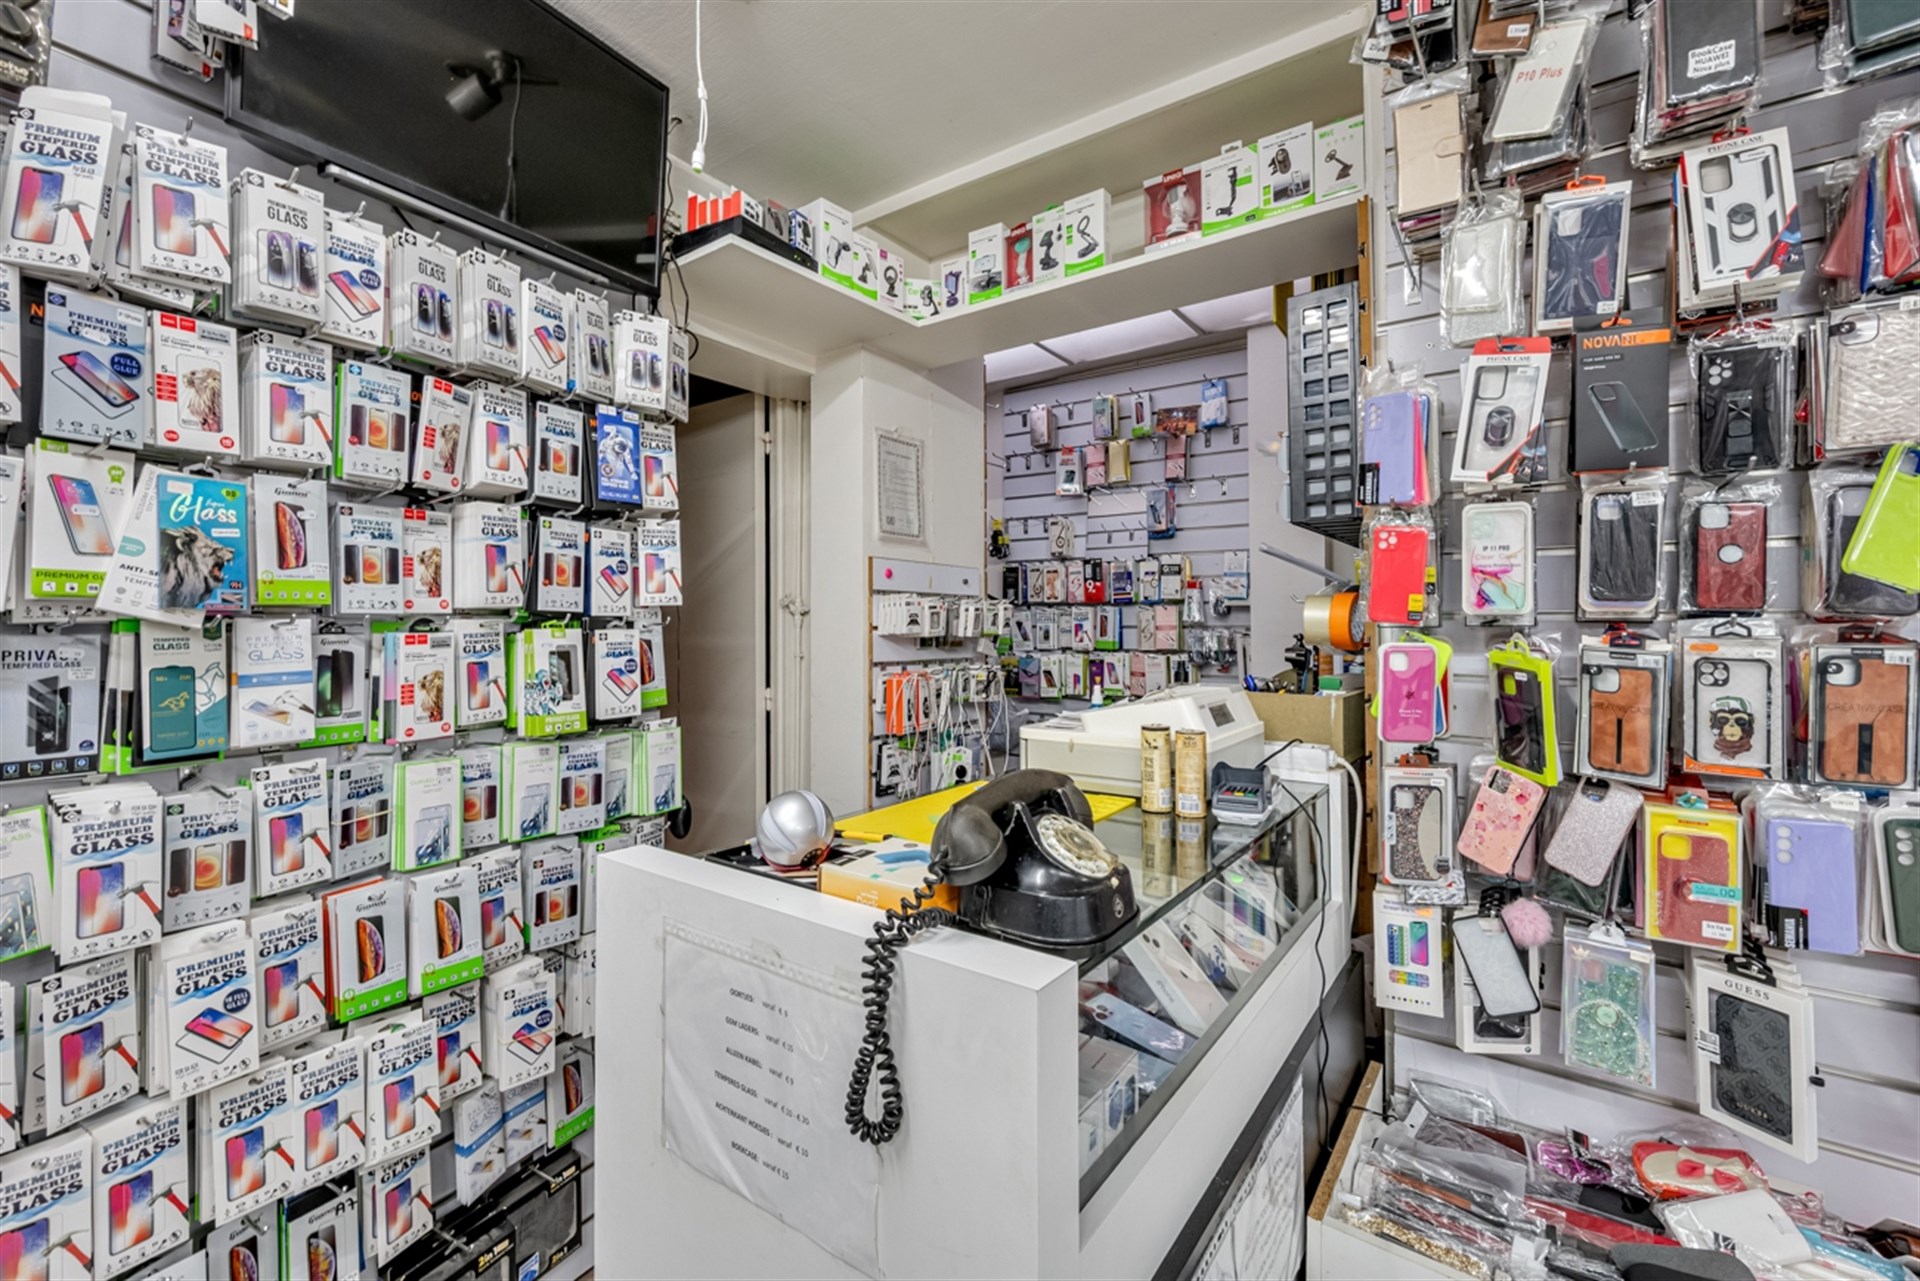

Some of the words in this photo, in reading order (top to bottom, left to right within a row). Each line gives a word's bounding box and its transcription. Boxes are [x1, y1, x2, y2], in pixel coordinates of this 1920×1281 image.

[1690, 43, 1733, 59] BookCase
[1694, 52, 1730, 65] HUAWEI
[1516, 70, 1536, 83] P10
[1539, 67, 1564, 78] Plus
[1693, 62, 1712, 74] Nova
[1714, 60, 1731, 71] plus
[24, 121, 100, 144] PREMIUM
[25, 133, 98, 152] TEMPERED
[1707, 140, 1738, 152] PHONE
[1740, 135, 1763, 145] CASE
[20, 140, 98, 165] GLASS
[146, 142, 219, 169] PREMIUM
[149, 152, 218, 176] TEMPERED
[146, 161, 221, 188] GLASS
[267, 206, 308, 229] GLASS
[330, 234, 375, 252] PREMIUM
[330, 242, 375, 260] TEMPERED
[328, 247, 375, 267] GLASS
[418, 262, 446, 284] GLASS
[487, 278, 511, 298] GLASS
[68, 310, 128, 332] PREMIUM
[534, 305, 563, 323] GLASS
[587, 315, 604, 330] GLASS
[70, 320, 126, 338] TEMPERED
[632, 333, 658, 346] GLASS
[1583, 334, 1636, 349] NOVANI
[114, 356, 139, 368] FULL
[265, 346, 326, 363] PREMIUM
[267, 354, 325, 371] TEMPERED
[113, 363, 139, 377] GLUE
[265, 361, 326, 381] GLASS
[359, 377, 401, 392] PRIVACY
[483, 392, 523, 406] PREMIUM
[484, 399, 522, 412] TEMPERED
[546, 416, 576, 427] PRIVACY
[545, 425, 576, 439] GLASS
[640, 440, 673, 452] GLASS
[169, 493, 237, 525] Glass
[351, 518, 392, 530] PRIVACY
[481, 514, 518, 525] PREMIUM
[482, 521, 517, 531] TEMPERED
[481, 527, 518, 538] GLASS
[641, 527, 677, 538] PREMIUM
[642, 533, 676, 543] TEMPERED
[641, 538, 678, 547] GLASS
[36, 570, 89, 580] PREMIUM
[463, 632, 501, 643] PREMIUM
[464, 638, 501, 647] TEMPERED
[153, 642, 190, 651] GLASS
[463, 643, 501, 654] GLASS
[1, 660, 50, 669] TEMPERED
[52, 658, 82, 668] GLASS
[1827, 703, 1874, 713] CREATIVE
[566, 751, 598, 762] PRIVACY
[565, 761, 599, 772] GLASS
[263, 775, 321, 791] PREMIUM
[348, 774, 383, 786] PRIVACY
[265, 782, 321, 799] TEMPERED
[347, 785, 384, 800] GLASS
[72, 814, 154, 834] PREMIUM
[180, 822, 239, 839] GLASS
[73, 825, 152, 842] TEMPERED
[70, 832, 154, 856] GLASS
[541, 862, 573, 873] PRIVACY
[478, 876, 519, 895] GLASS
[540, 873, 574, 886] GLASS
[259, 917, 318, 940] PREMIUM
[261, 925, 317, 947] TEMPERED
[259, 932, 318, 959] GLASS
[175, 949, 246, 976] PREMIUM
[177, 959, 245, 982] TEMPERED
[53, 970, 128, 1002] PREMIUM
[175, 966, 247, 996] GLASS
[1724, 979, 1771, 1000] GUESS
[56, 980, 127, 1010] TEMPERED
[512, 989, 547, 1007] PREMIUM
[52, 986, 129, 1024] GLASS
[512, 1000, 548, 1017] GLASS
[300, 1054, 359, 1082] PREMIUM
[379, 1046, 432, 1075] GLASS
[301, 1061, 358, 1090] TEMPERED
[299, 1070, 359, 1100] GLASS
[219, 1078, 287, 1110] PREMIUM
[218, 1094, 287, 1128] GLASS
[221, 1087, 287, 1119] TEMPERED
[102, 1117, 180, 1154] PREMIUM
[104, 1127, 178, 1162] TEMPERED
[102, 1134, 181, 1175] GLASS
[380, 1153, 426, 1184] GLASS
